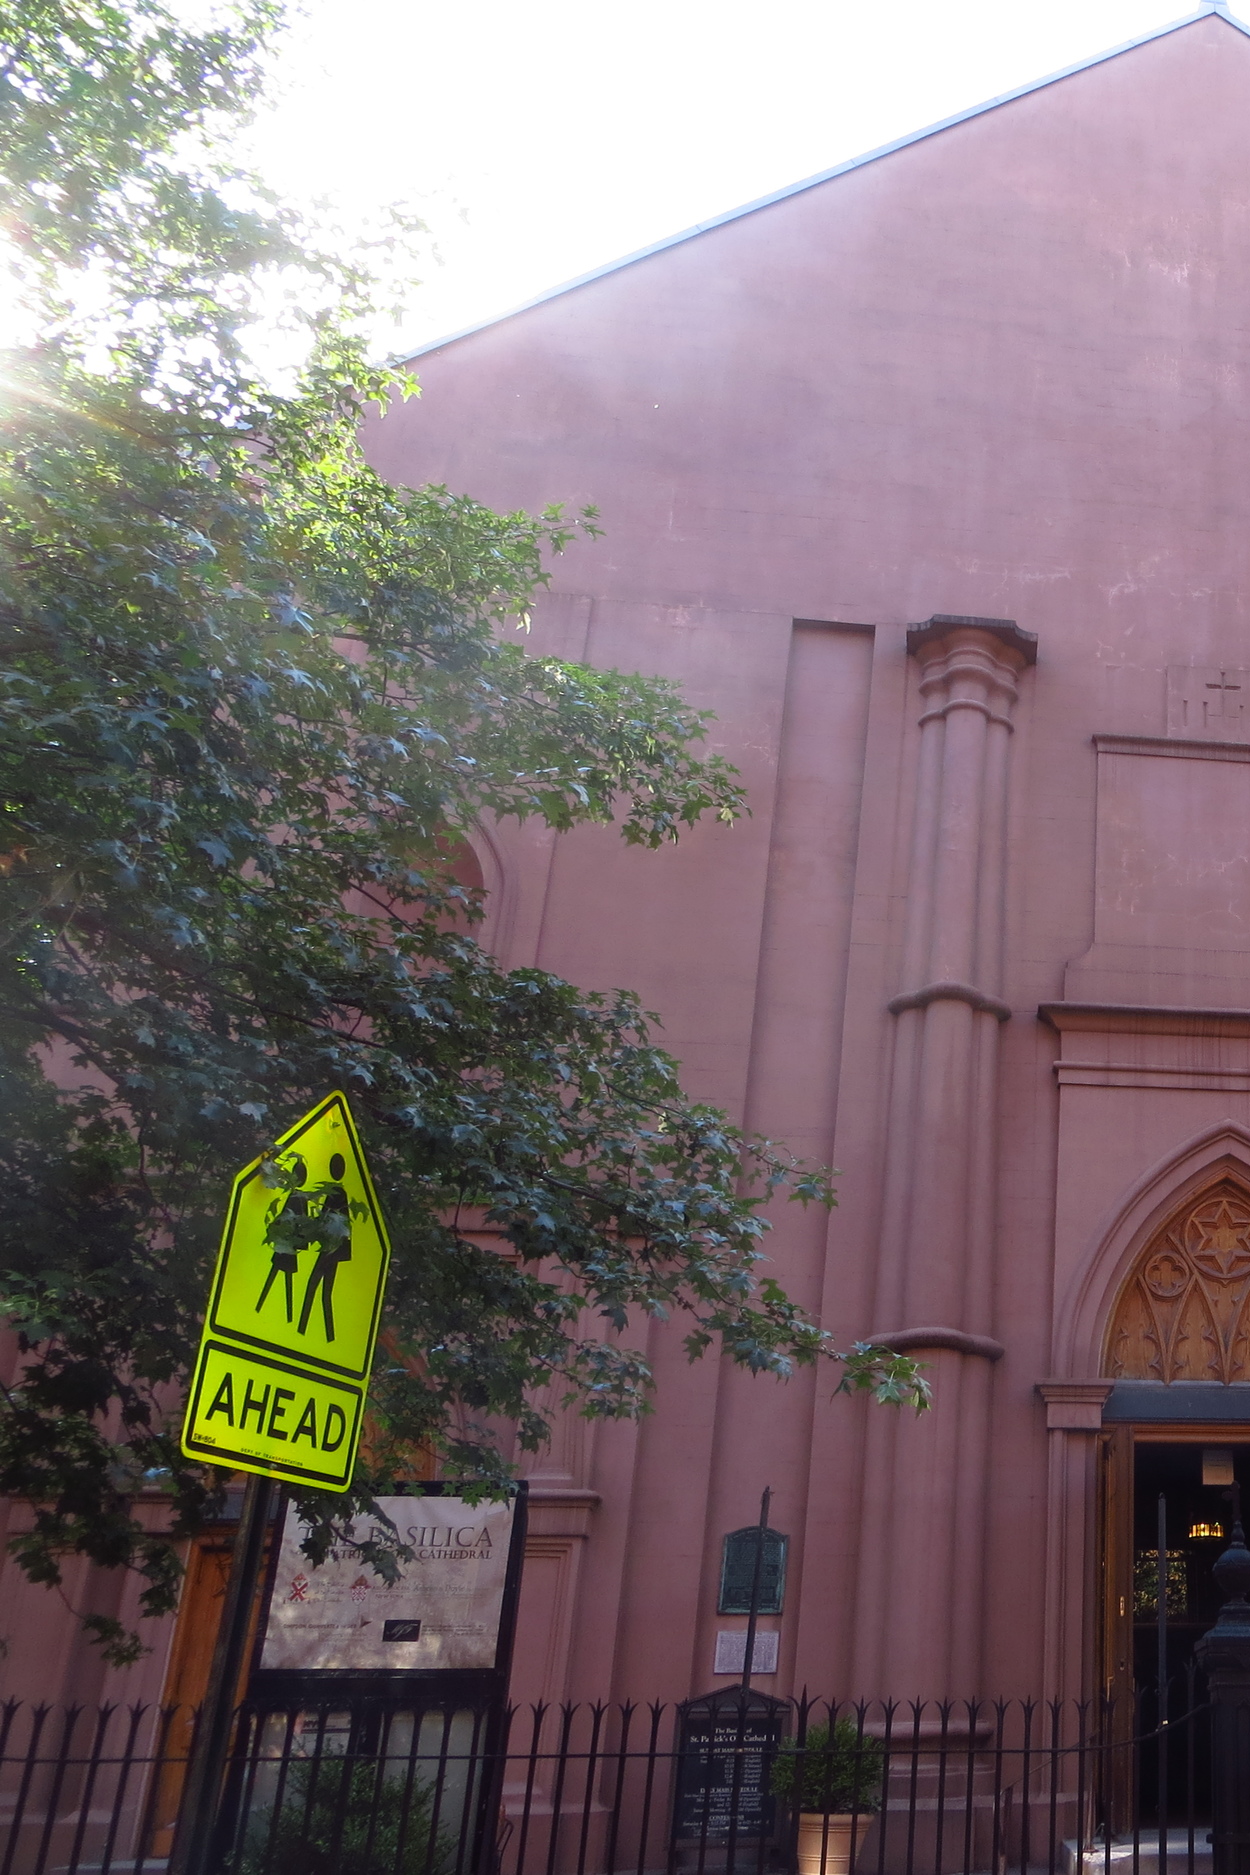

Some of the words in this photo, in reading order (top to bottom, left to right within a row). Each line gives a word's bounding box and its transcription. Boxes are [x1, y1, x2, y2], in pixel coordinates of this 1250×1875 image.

[204, 1372, 347, 1452] AHEAD
[262, 1452, 304, 1467] TRANSPORTATION
[419, 1549, 492, 1560] CATHEDRAL
